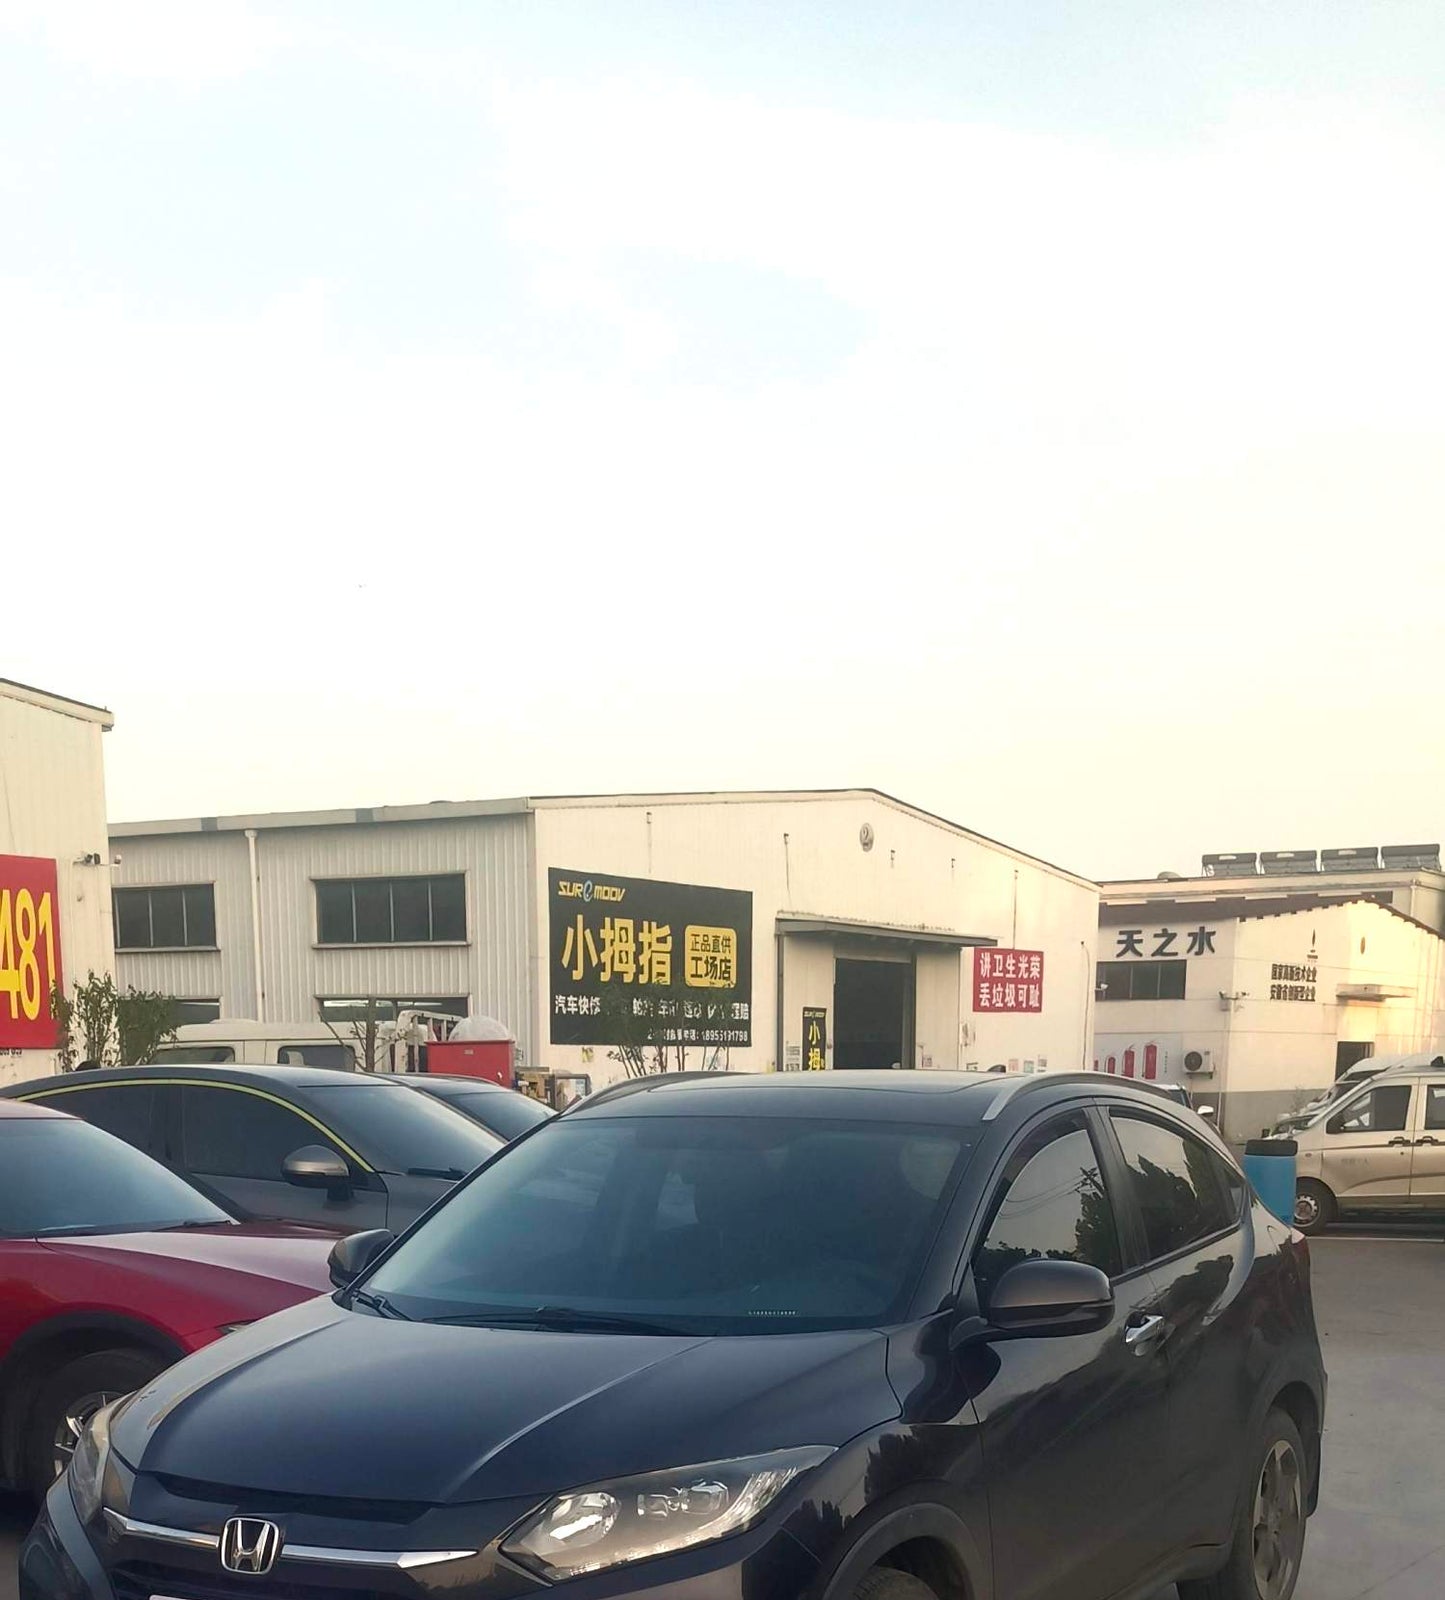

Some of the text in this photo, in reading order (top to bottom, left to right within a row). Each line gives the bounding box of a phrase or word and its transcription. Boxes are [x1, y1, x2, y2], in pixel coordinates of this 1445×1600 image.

[561, 914, 673, 985] 小拇指
[690, 933, 731, 954] 正品直供
[1116, 926, 1216, 958] 天之水
[690, 956, 732, 981] 工场店
[979, 952, 1040, 980] 讲卫生光荣
[979, 982, 1040, 1009] 丢垃圾可耻
